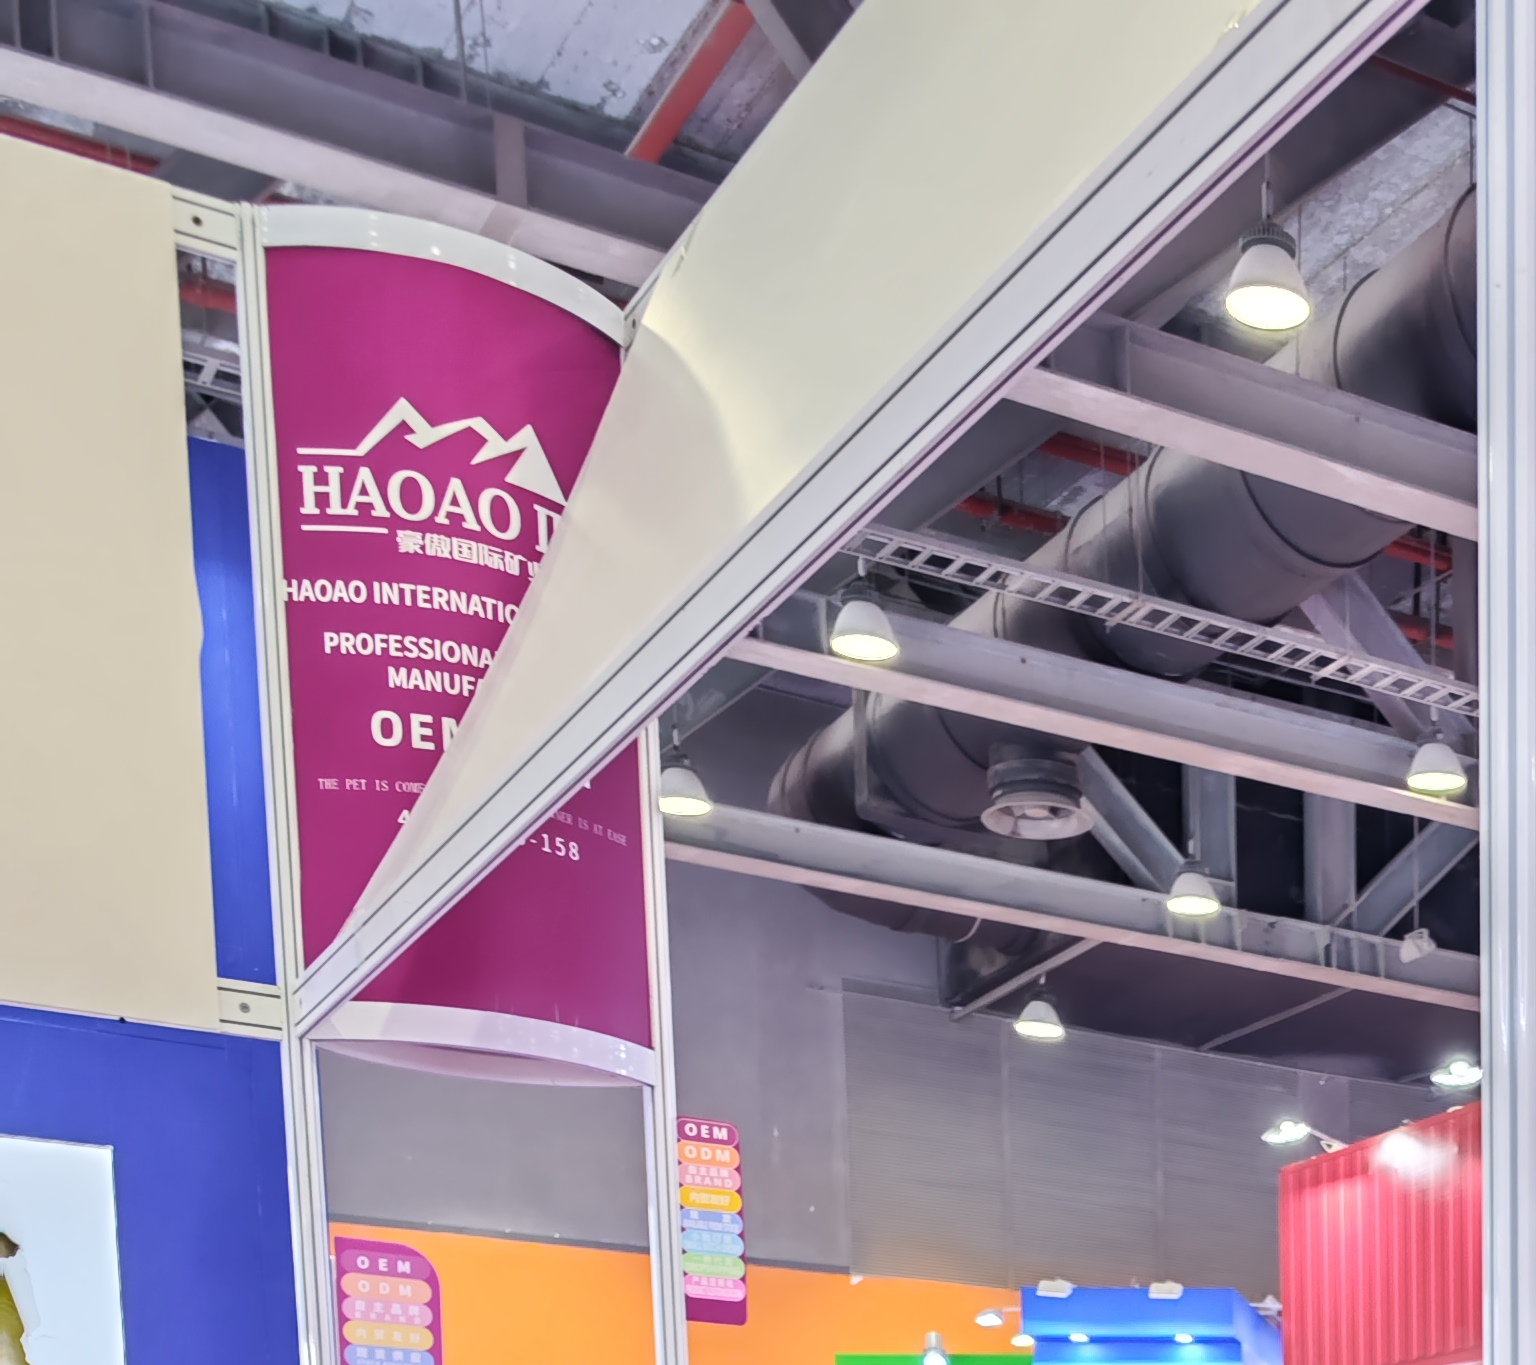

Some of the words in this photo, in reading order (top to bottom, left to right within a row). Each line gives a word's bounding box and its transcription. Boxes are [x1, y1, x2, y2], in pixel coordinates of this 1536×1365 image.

[298, 464, 521, 540] HAOAO
[283, 579, 367, 603] HAOAO
[318, 778, 339, 790] THE
[345, 778, 366, 791] PET
[375, 779, 389, 792] IS
[684, 1123, 728, 1141] OEM
[684, 1146, 731, 1163] ODM
[356, 1256, 411, 1275] OEM
[358, 1280, 413, 1297] ODM
